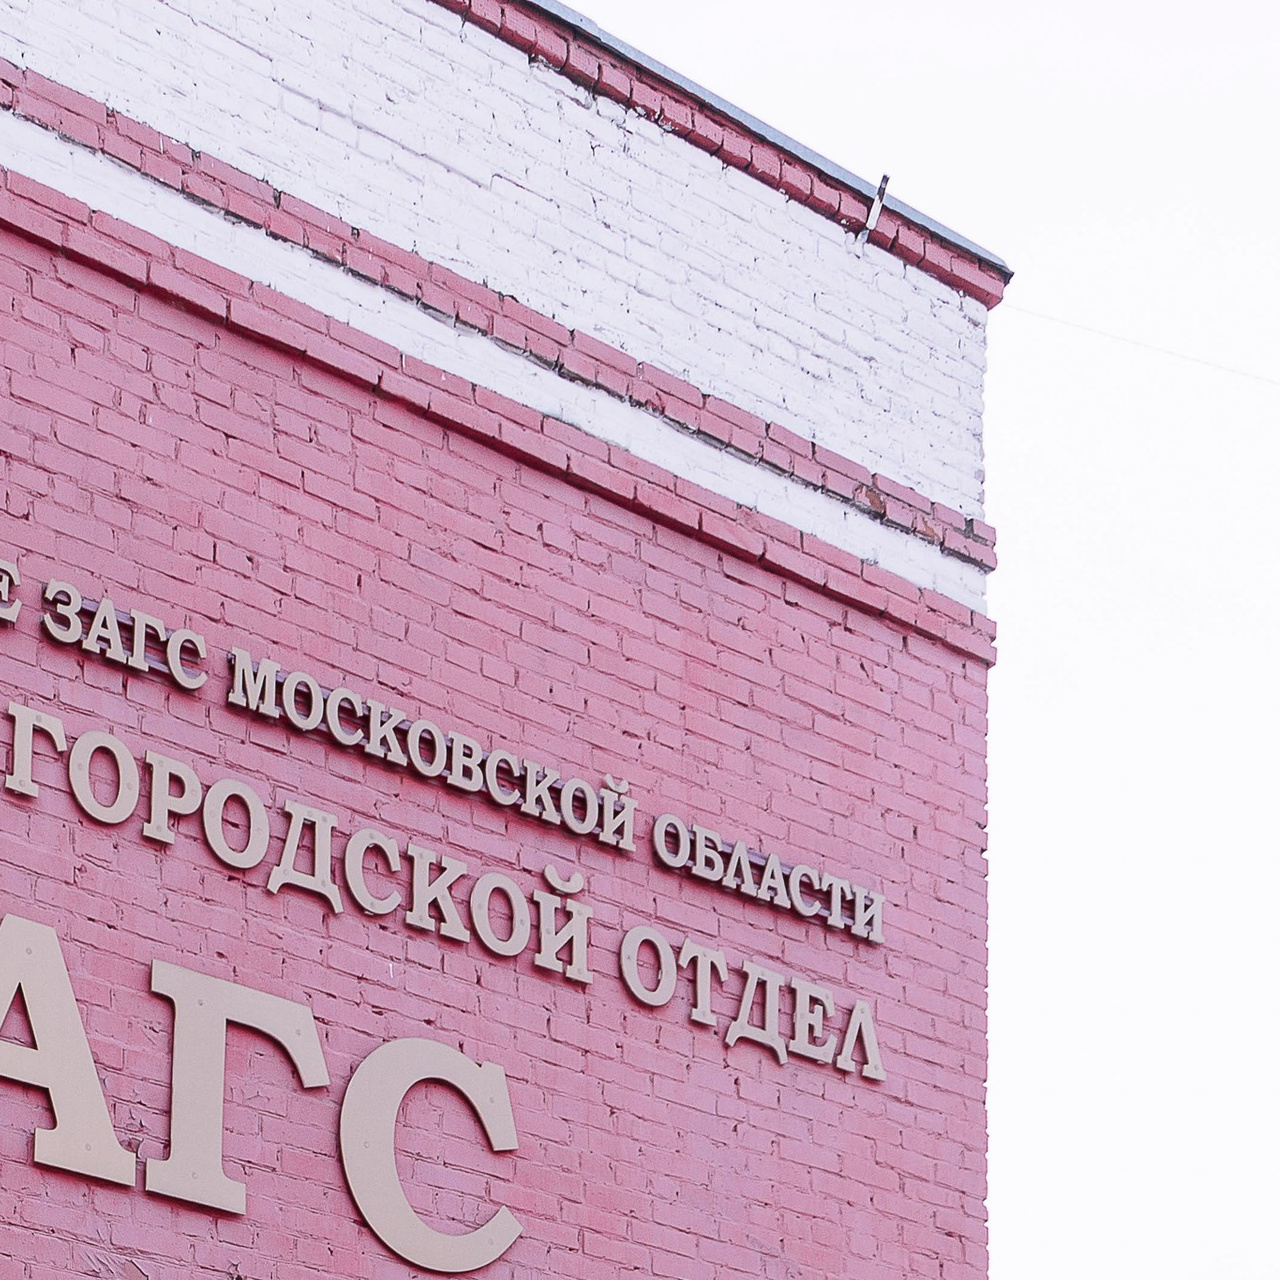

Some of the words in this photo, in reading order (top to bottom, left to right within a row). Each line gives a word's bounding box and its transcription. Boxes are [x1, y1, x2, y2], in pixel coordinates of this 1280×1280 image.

[4, 700, 595, 985] ГОРОДСКОЙ
[620, 924, 888, 1082] ОТДЕЛ
[42, 577, 210, 692] ЗАГС
[228, 645, 637, 852] МОСКОВСКОЙ
[652, 812, 886, 944] ОБЛАСТИ
